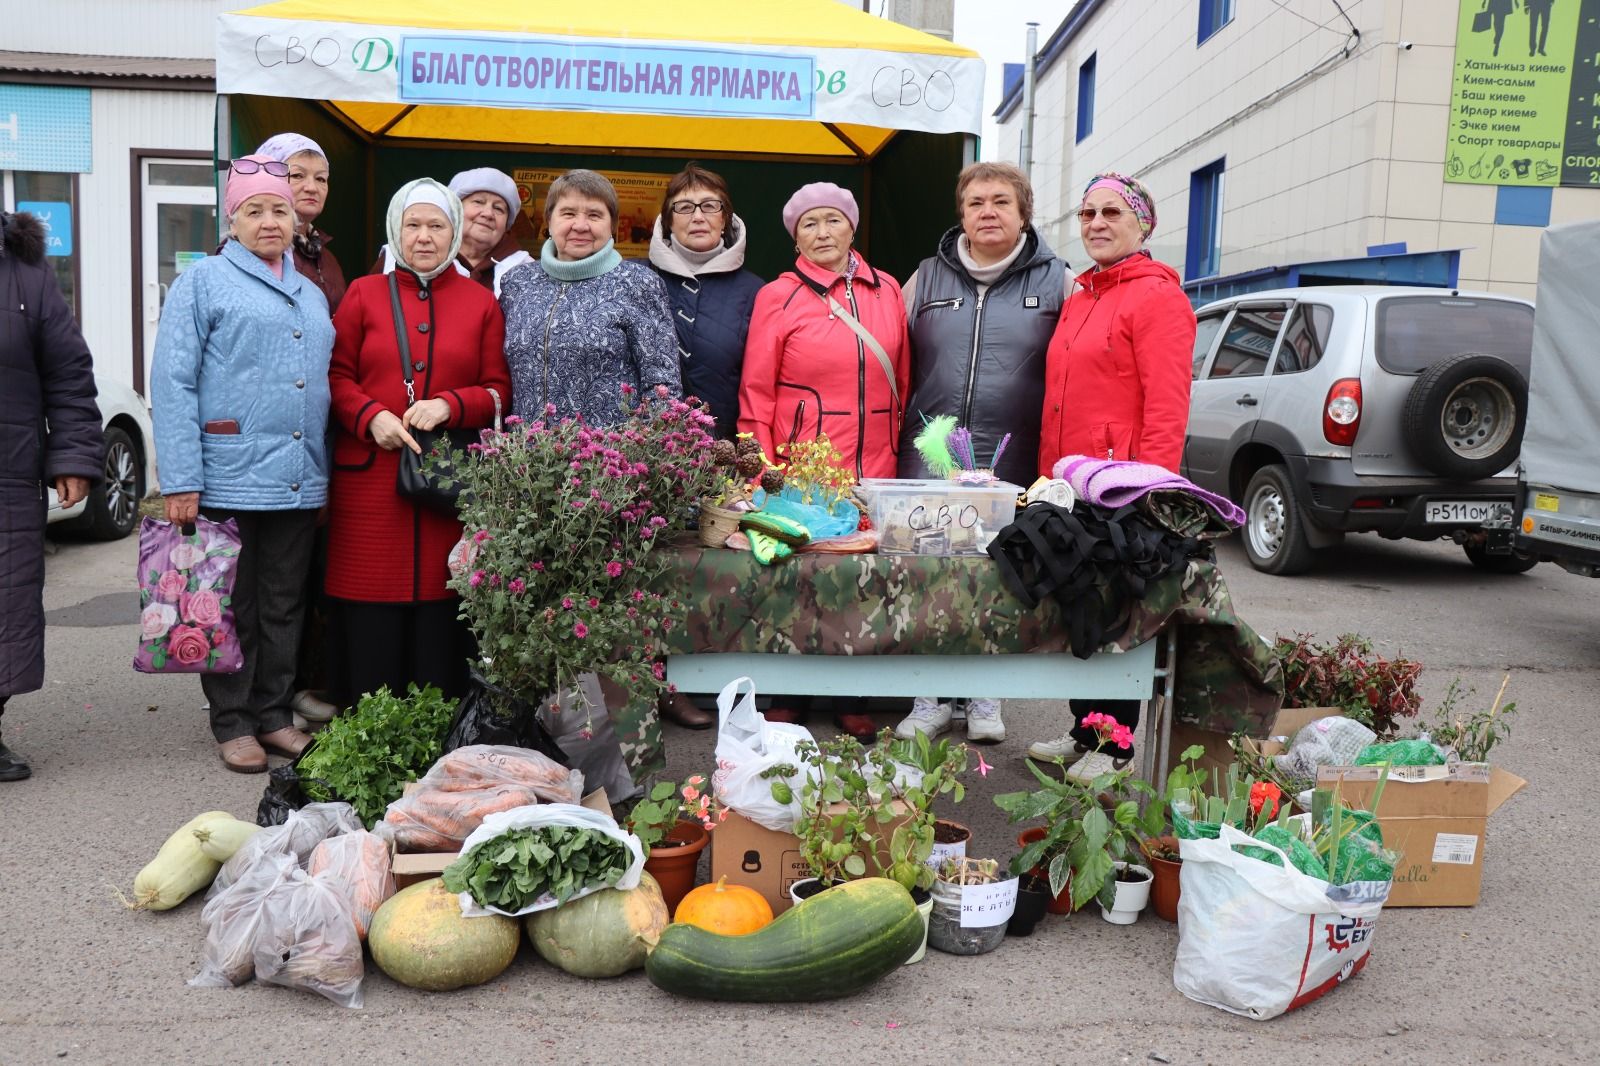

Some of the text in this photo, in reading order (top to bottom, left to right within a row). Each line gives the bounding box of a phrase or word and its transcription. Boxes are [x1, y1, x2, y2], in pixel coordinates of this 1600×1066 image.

[254, 34, 341, 68] СВО
[1464, 59, 1566, 73] Хатын-кыз киеме
[412, 51, 801, 102] БЛАГОТВОРИТЕЛЬНАЯ ЯРМАРКА
[1463, 74, 1536, 87] Кием-салым
[871, 65, 956, 112] СВО
[1461, 90, 1526, 102] Баш киеме
[1460, 104, 1537, 118] Ирләр киеме
[1459, 120, 1521, 132] Эчке кием
[1458, 134, 1561, 151] Спорт товарлары
[517, 172, 548, 182] ЦЕНТР
[908, 505, 979, 531] СВО
